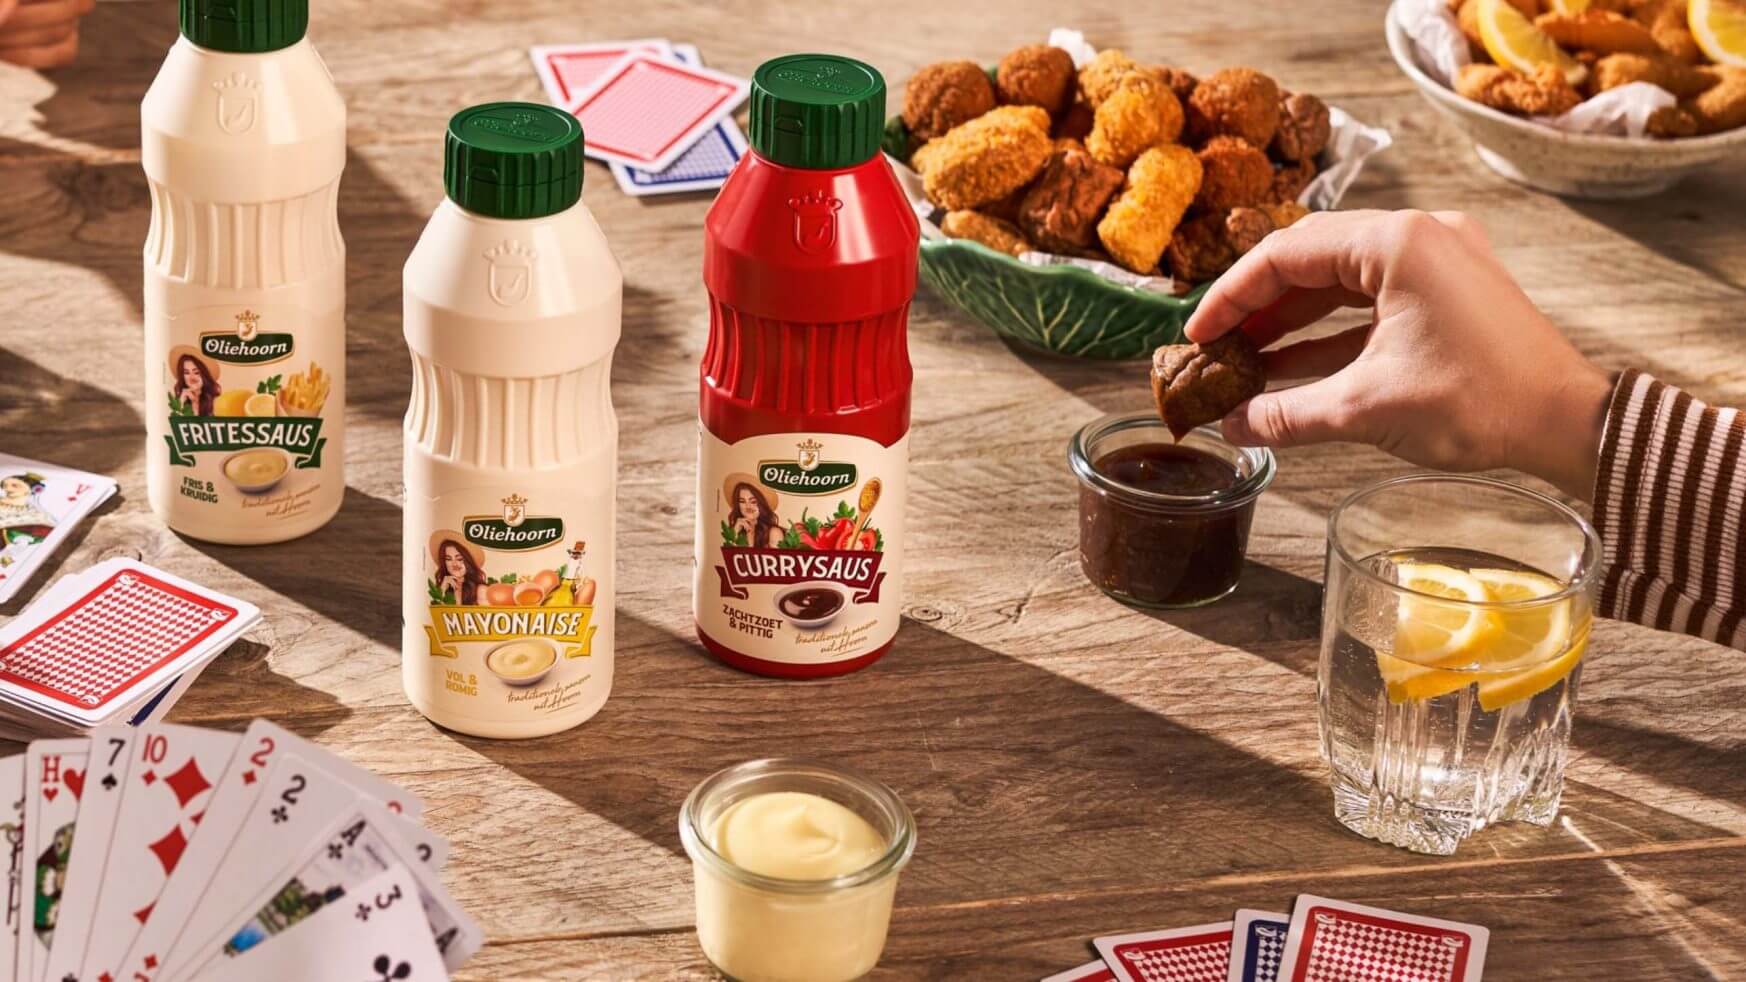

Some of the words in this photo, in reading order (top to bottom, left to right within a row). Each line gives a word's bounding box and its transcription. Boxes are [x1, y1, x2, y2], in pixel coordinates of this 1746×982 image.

[205, 338, 288, 356] Oliehoorn
[178, 422, 313, 447] FRITESSAUS
[183, 476, 204, 492] FRIS
[206, 481, 214, 492] &
[764, 467, 849, 486] Oliehoorn
[180, 486, 219, 504] KRUIDIG
[469, 523, 557, 542] Oliehoorn
[732, 553, 873, 581] CURRYSAUS
[442, 612, 583, 636] MAYONAISE
[722, 604, 783, 630] ZACHTZOET
[729, 617, 737, 629] &
[739, 623, 774, 639] PITTIG
[445, 681, 478, 697] ROMIG
[446, 670, 466, 684] VOL
[468, 674, 478, 685] &
[108, 738, 127, 767] 7
[142, 734, 168, 764] 10
[250, 737, 275, 767] 2
[41, 755, 61, 784] H
[281, 774, 307, 805] 2
[340, 819, 367, 847] A
[375, 884, 403, 910] 3
